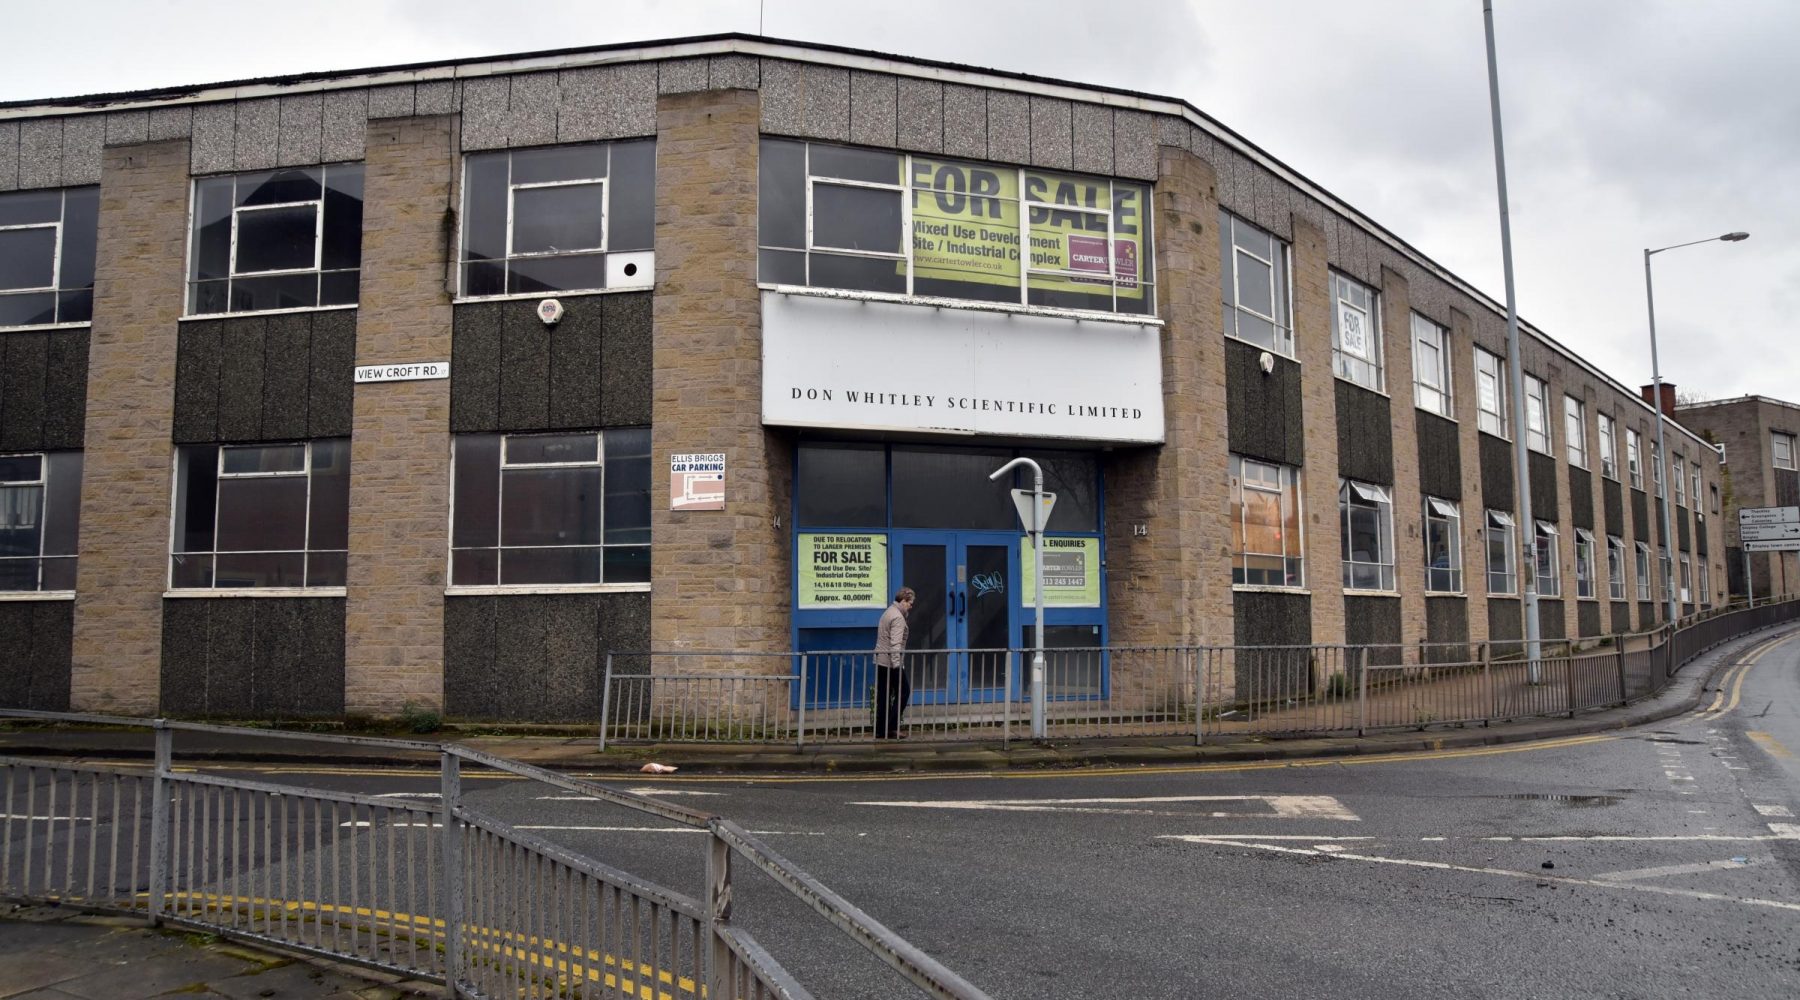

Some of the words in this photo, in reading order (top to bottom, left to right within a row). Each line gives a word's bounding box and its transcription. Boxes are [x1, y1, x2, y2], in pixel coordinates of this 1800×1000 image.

[912, 162, 1002, 219] FOR
[1025, 176, 1137, 235] SALE
[953, 225, 976, 240] Use
[980, 229, 1061, 249] Develoment
[912, 236, 934, 250] Site
[947, 241, 1006, 259] Industrial
[1344, 312, 1360, 334] FOR
[1345, 331, 1361, 351] SALE
[358, 368, 383, 379] VIEW
[386, 366, 420, 377] CROFT
[792, 387, 832, 401] DON
[846, 390, 935, 407] WHITLEY
[948, 397, 1056, 414] SCIENTIFIC
[1068, 405, 1142, 419] LIMITED
[695, 454, 724, 462] BRIGGS
[689, 463, 723, 471] PARKING
[773, 515, 780, 529] 14
[1134, 524, 1147, 536] 14
[1049, 539, 1086, 548] ENQUIRIES
[813, 552, 837, 563] FOR
[840, 552, 872, 563] SALE
